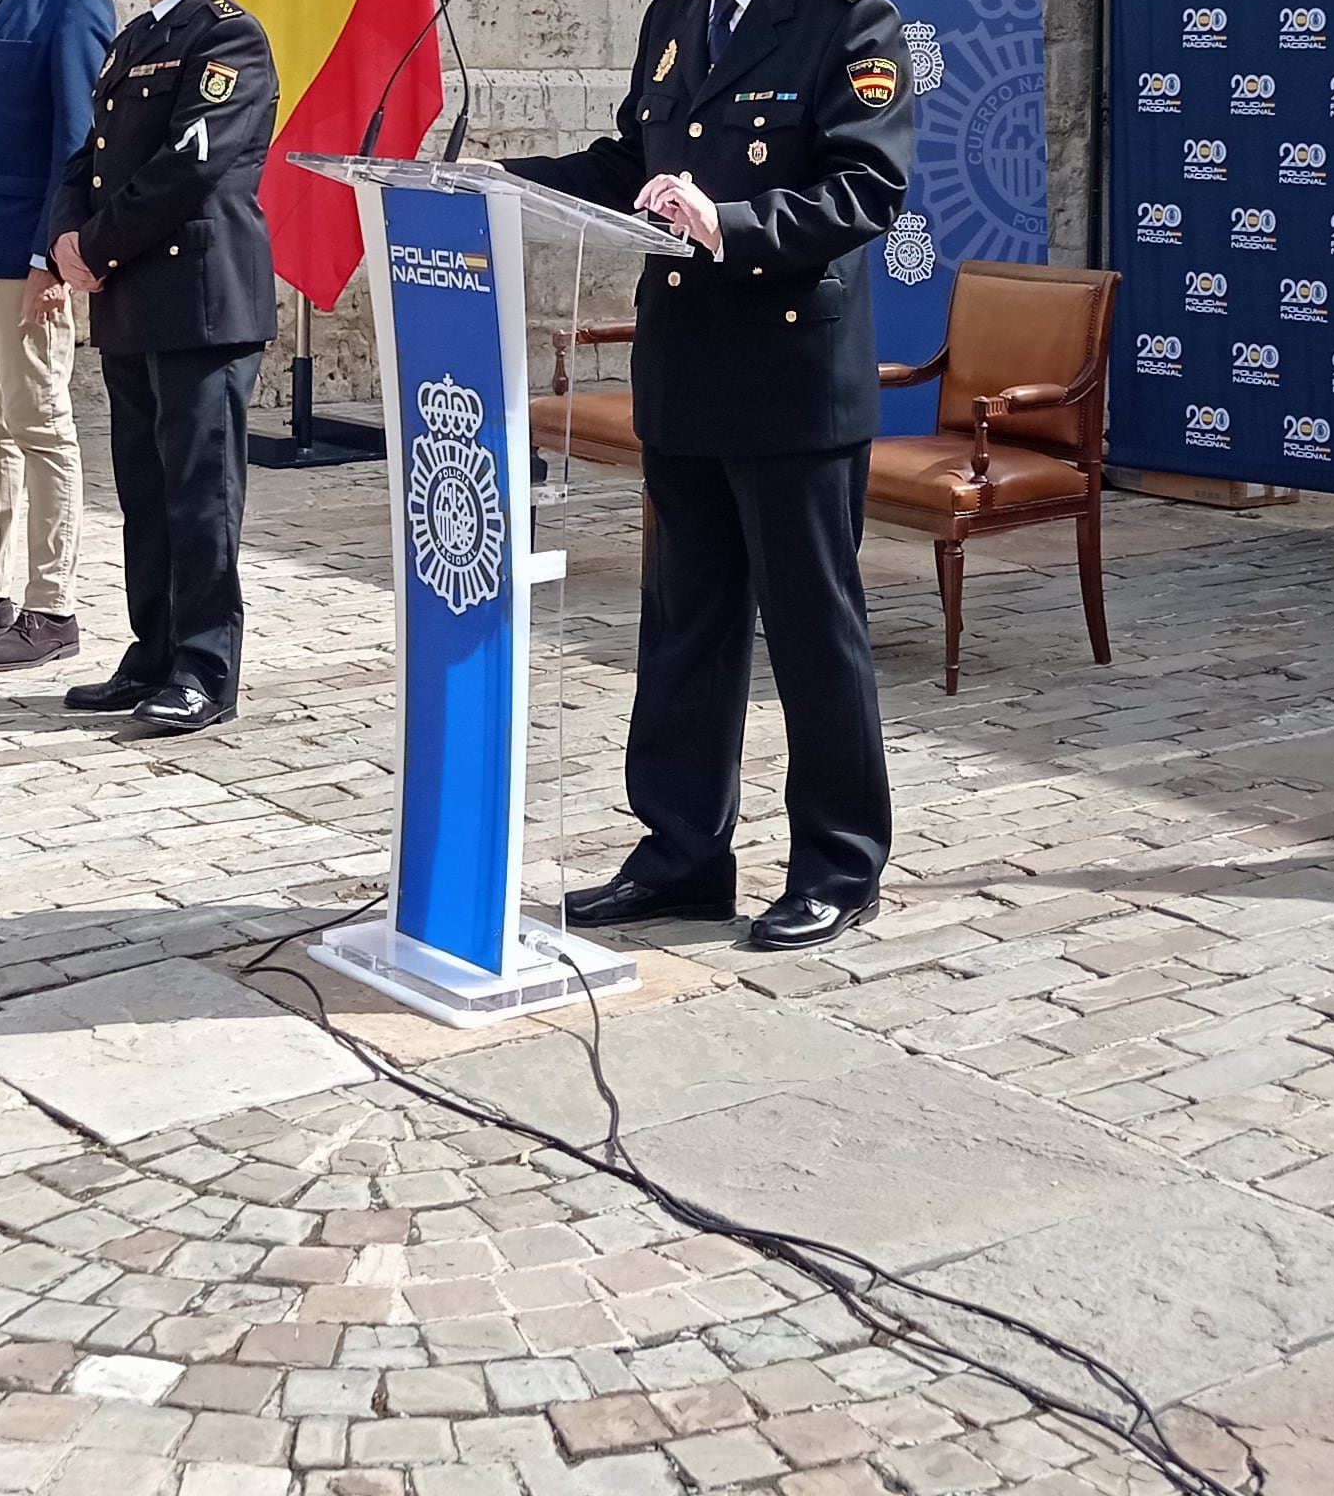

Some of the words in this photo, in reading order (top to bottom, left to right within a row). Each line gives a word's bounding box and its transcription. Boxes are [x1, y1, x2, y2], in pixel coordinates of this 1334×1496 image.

[1183, 8, 1227, 31] 200
[1280, 8, 1325, 32] 200
[1139, 73, 1180, 96] 200
[1231, 75, 1275, 98] 200
[968, 84, 1013, 165] CUERPO
[1184, 139, 1226, 163] 200
[1280, 143, 1326, 167] 200
[1138, 203, 1181, 227] 200
[1231, 208, 1276, 233] 200
[392, 265, 491, 292] NACIONAL
[1186, 272, 1227, 297] 200
[1280, 279, 1327, 304] 200
[1137, 334, 1181, 359] 200
[1233, 343, 1279, 368] 200
[1186, 405, 1229, 431] 200
[1284, 416, 1330, 442] 200
[435, 538, 477, 563] NACIONAL
